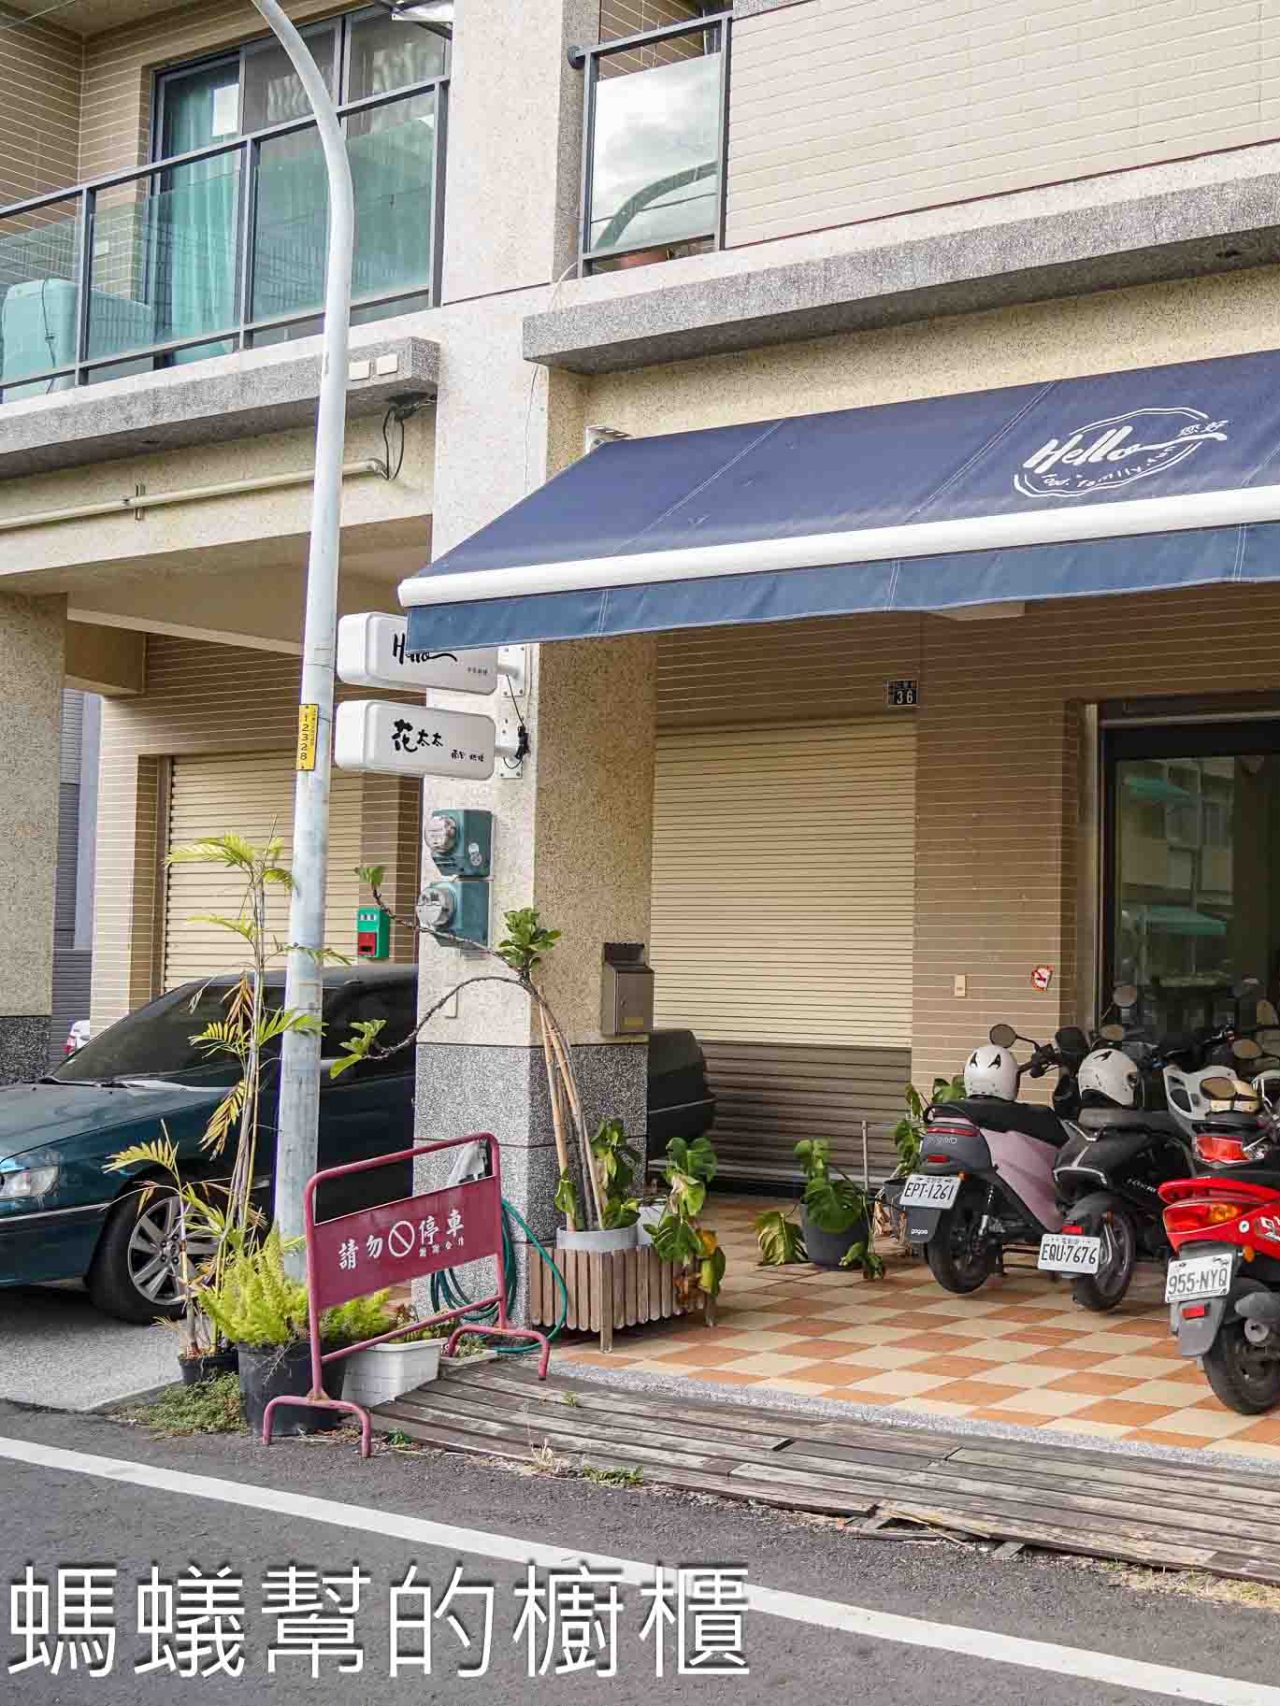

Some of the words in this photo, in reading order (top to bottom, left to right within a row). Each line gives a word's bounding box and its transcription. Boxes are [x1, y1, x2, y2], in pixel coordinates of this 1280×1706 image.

[1023, 425, 1228, 474] Hello
[896, 689, 913, 704] 36
[299, 714, 310, 761] 12328
[391, 719, 443, 752] 花太太
[904, 1182, 955, 1201] EPT-1261
[338, 1234, 384, 1271] 請勿
[418, 1208, 465, 1246] 停車
[1041, 1244, 1098, 1265] EQU-7676
[1168, 1269, 1228, 1295] 955-NYQ
